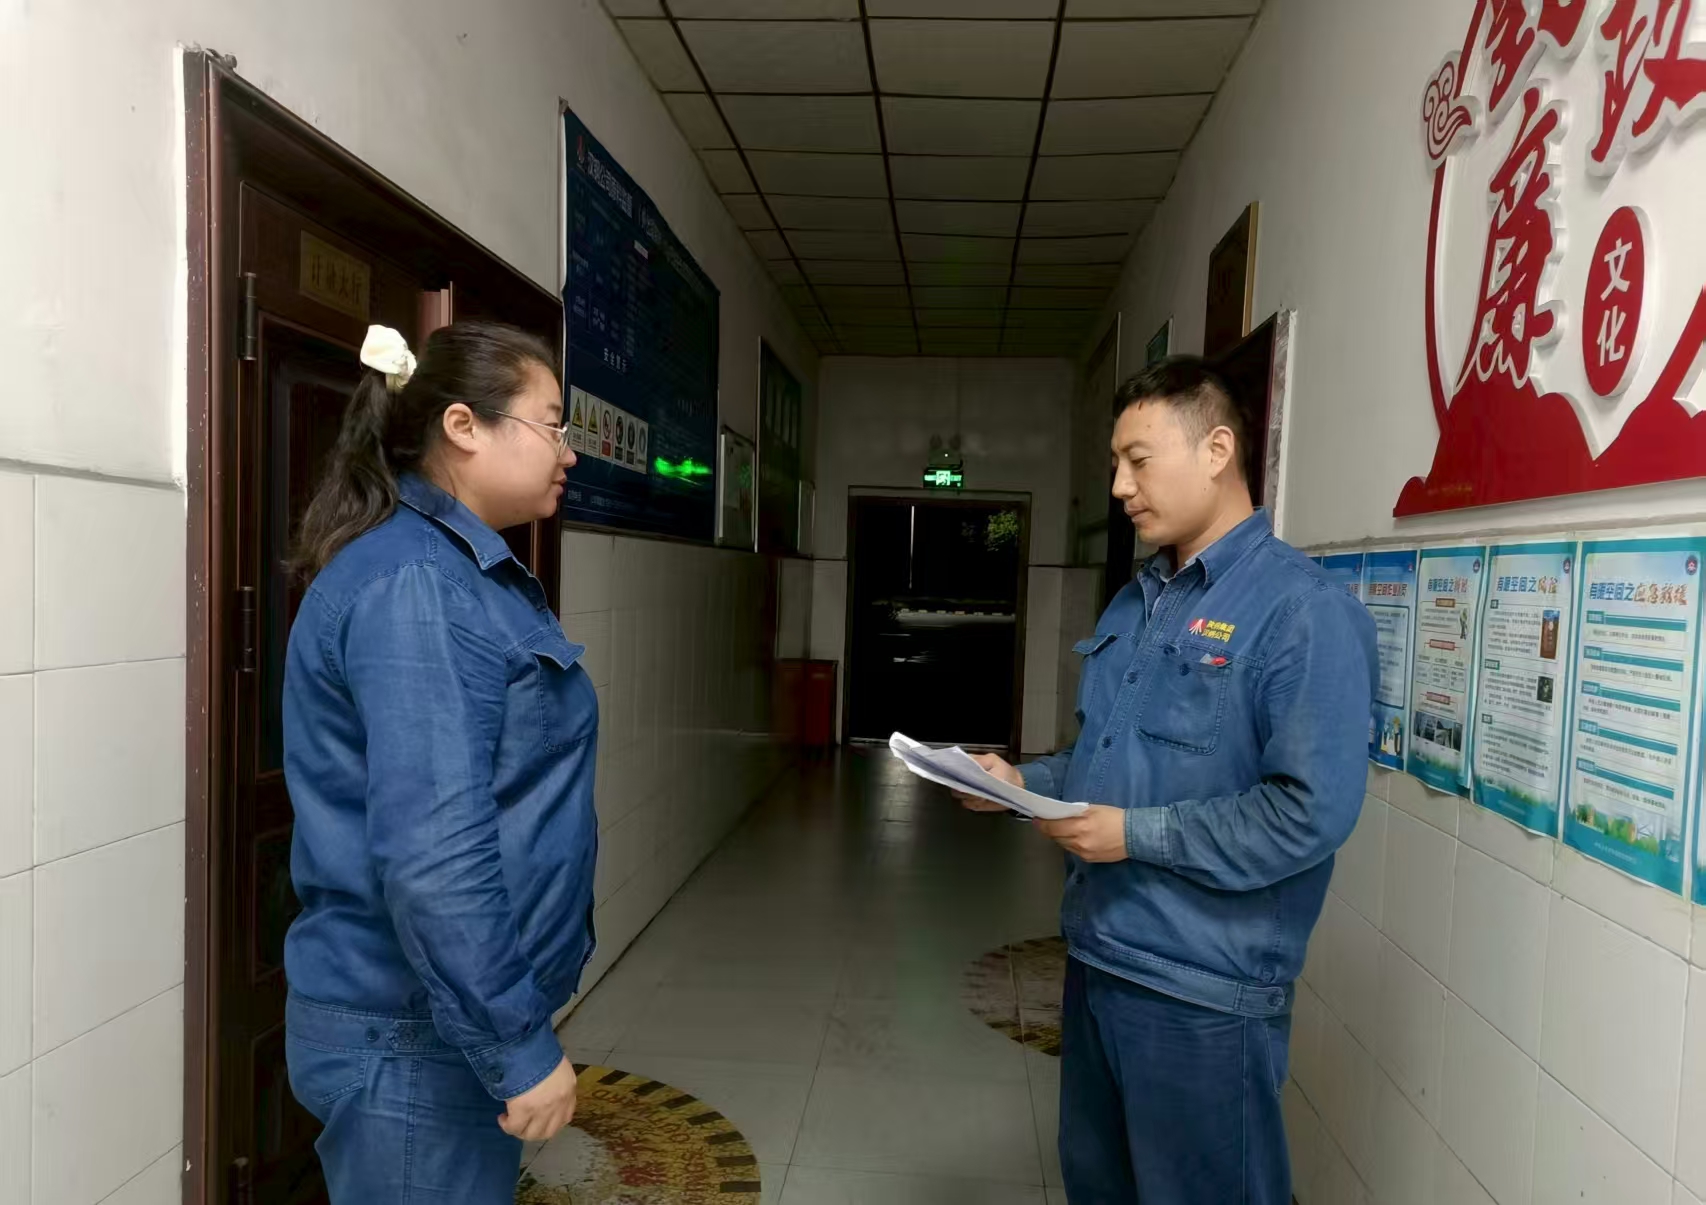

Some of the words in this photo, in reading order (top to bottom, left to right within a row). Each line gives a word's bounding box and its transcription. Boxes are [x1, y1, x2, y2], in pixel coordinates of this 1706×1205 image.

[1597, 237, 1633, 367] 文化
[1590, 582, 1687, 605] 有限空间之应急救援
